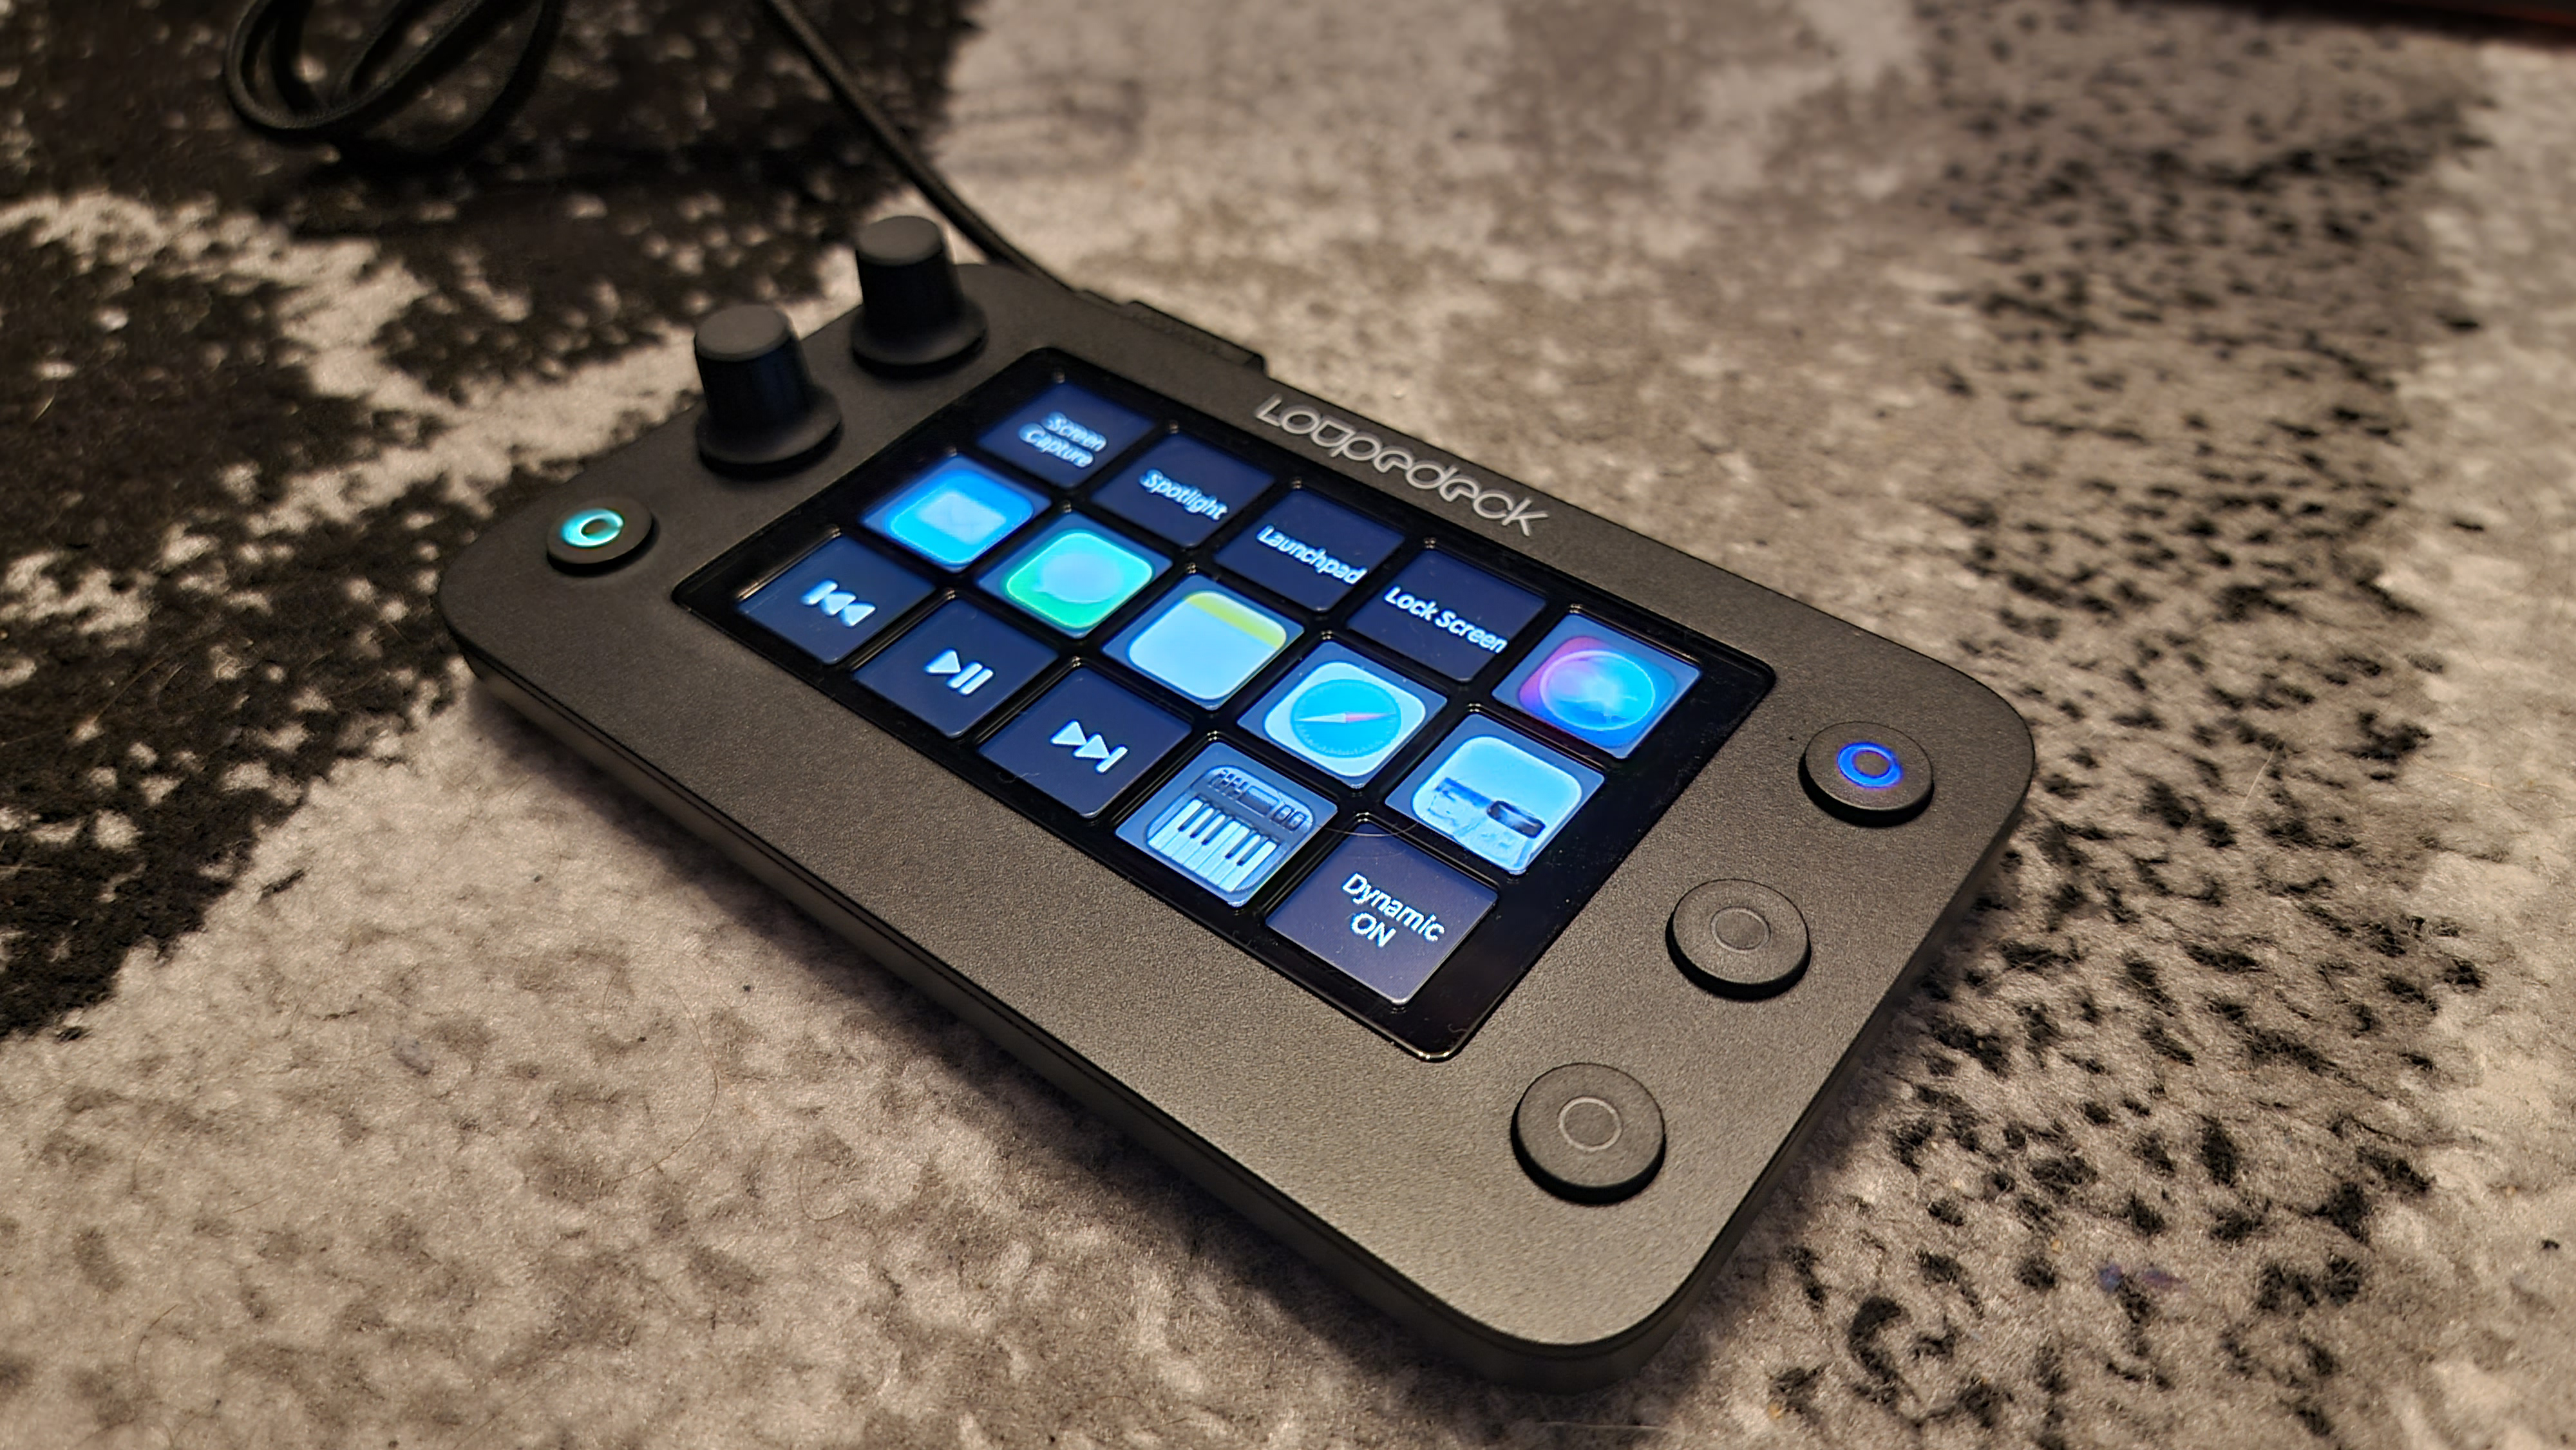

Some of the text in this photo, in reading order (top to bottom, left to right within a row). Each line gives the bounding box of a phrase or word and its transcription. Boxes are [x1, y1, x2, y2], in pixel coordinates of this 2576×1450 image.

[1019, 423, 1094, 468] Capture
[1042, 411, 1106, 451] Screen
[1255, 395, 1548, 536] Loupedeck
[1139, 468, 1227, 520] Spotlight
[1256, 525, 1367, 585] Launchpad
[1385, 586, 1508, 654] Lock Screen
[1343, 872, 1445, 942] Dynamic
[1351, 912, 1396, 947] ON
